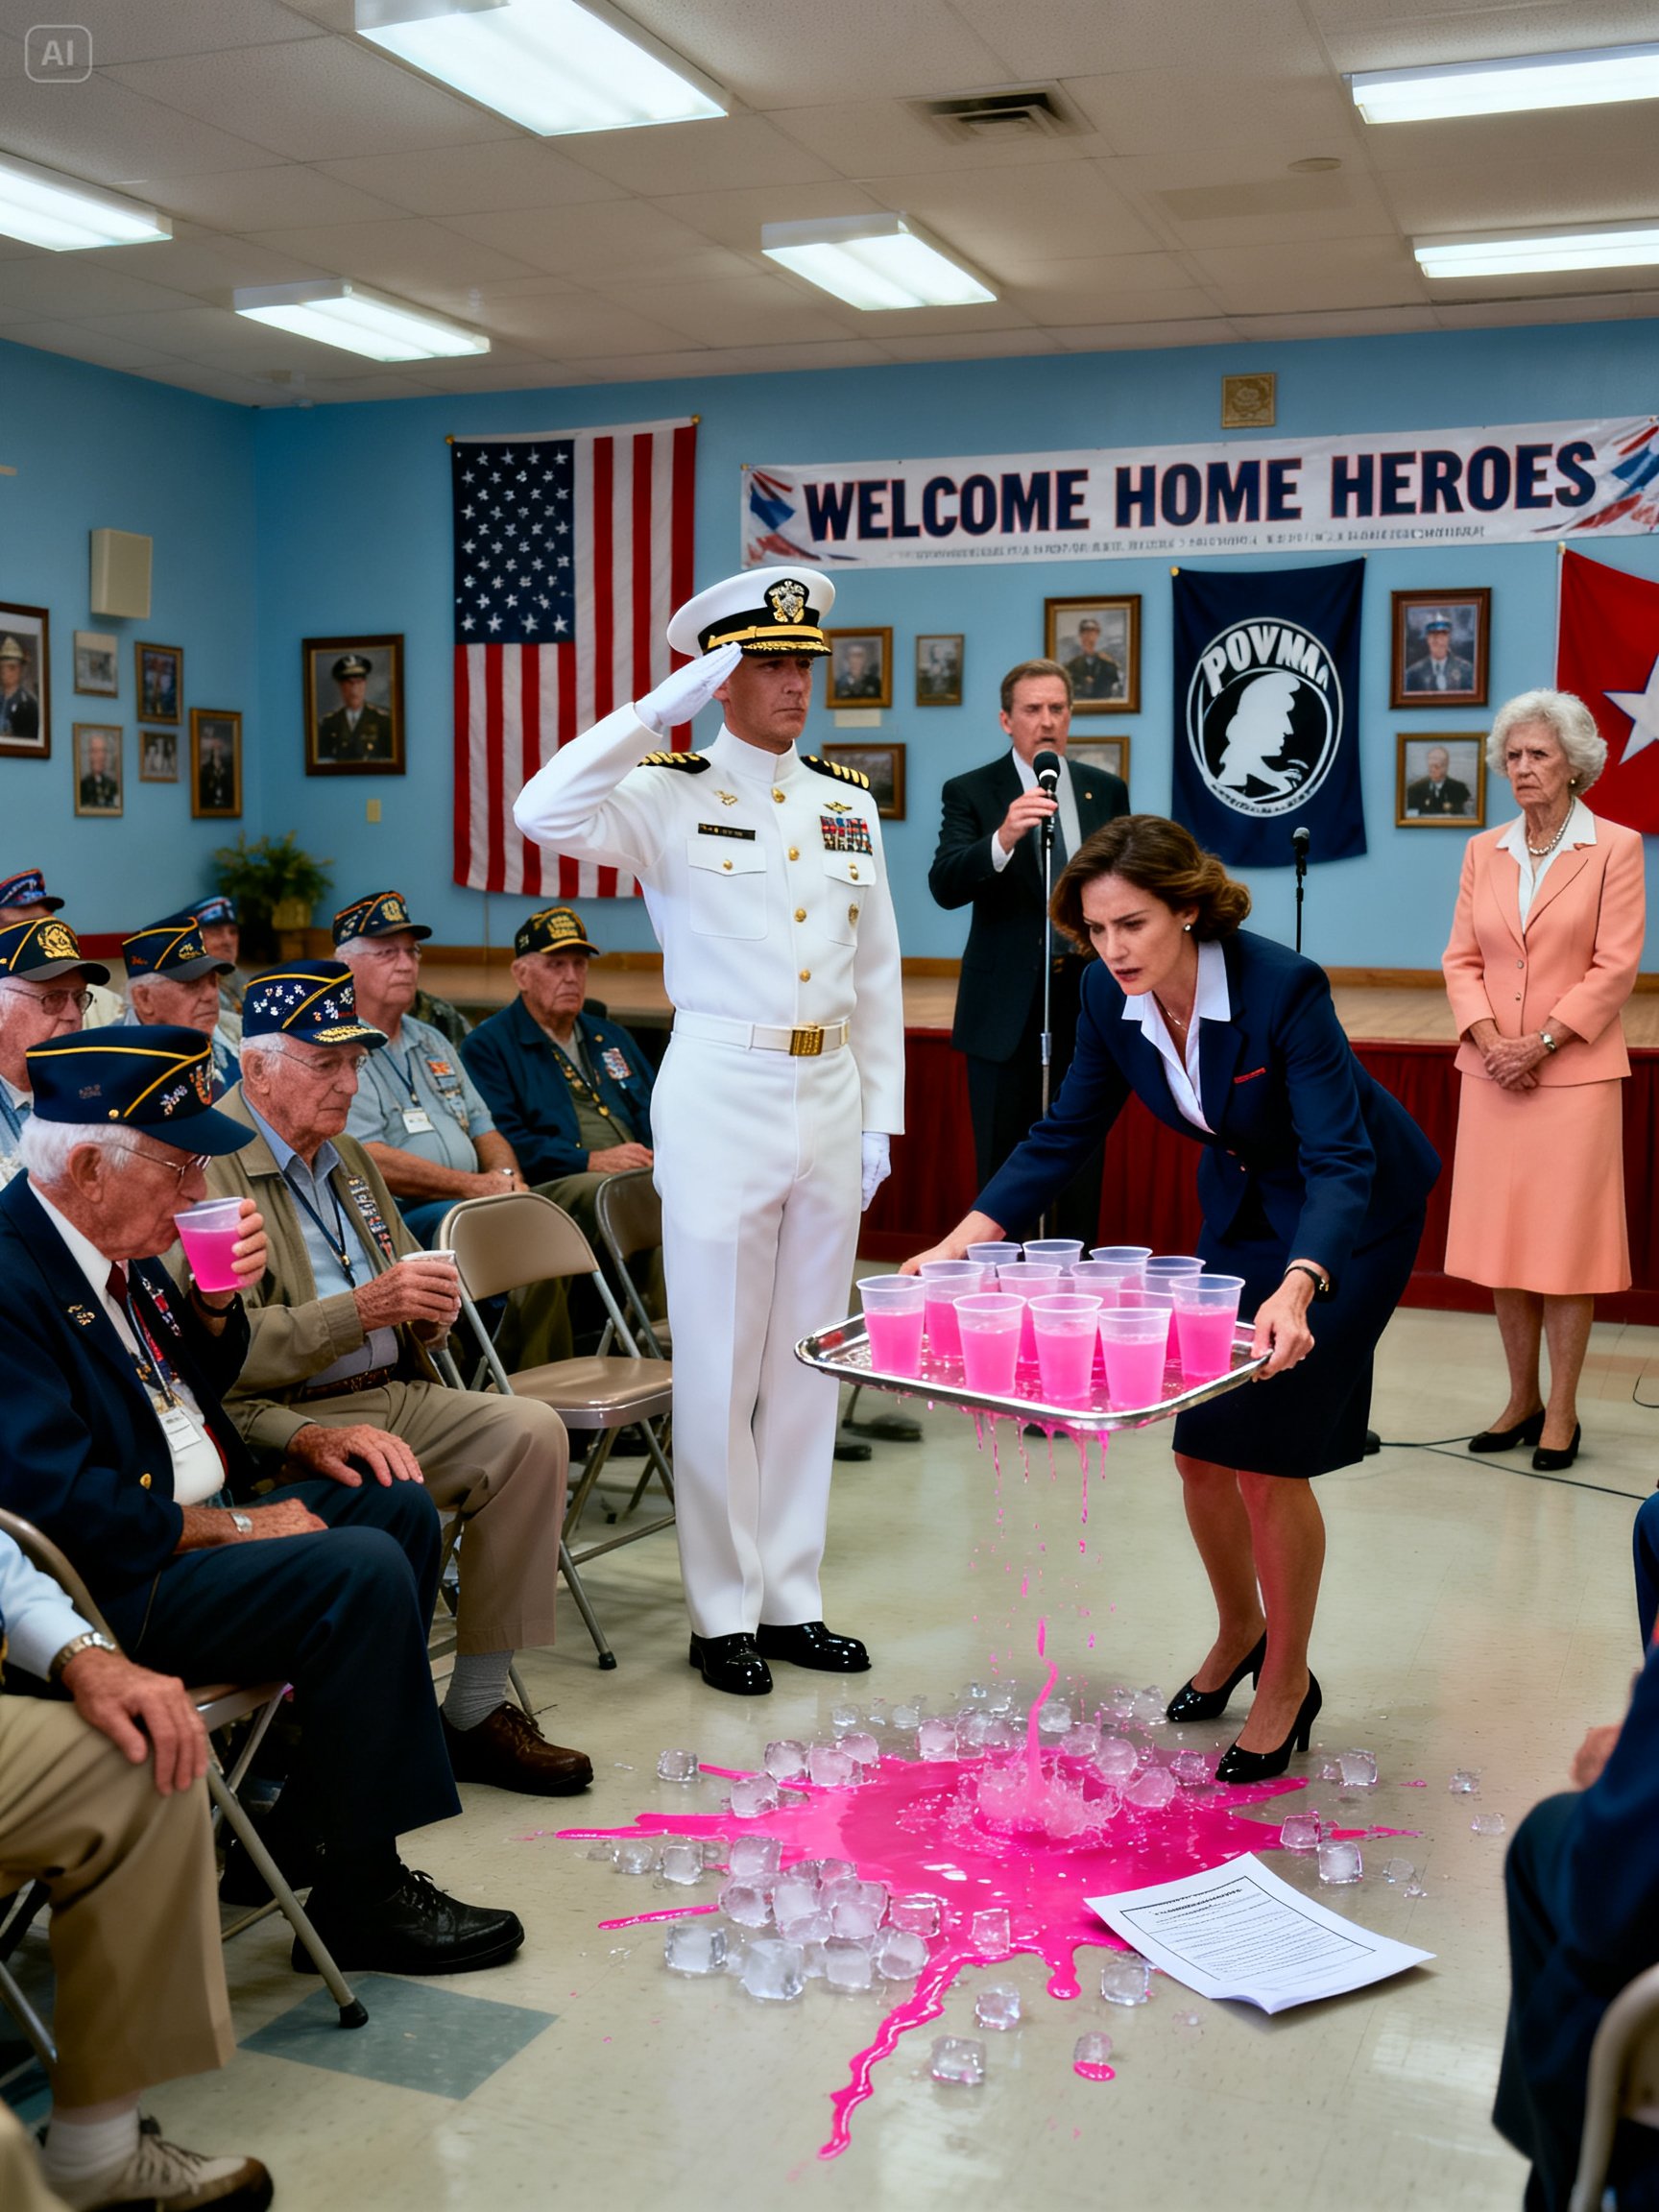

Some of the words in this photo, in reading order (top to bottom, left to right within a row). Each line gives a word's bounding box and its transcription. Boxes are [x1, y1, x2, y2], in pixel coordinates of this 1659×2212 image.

[804, 469, 1090, 541] WELCOME
[1116, 457, 1303, 529] HOME
[1331, 441, 1597, 518] HEROES
